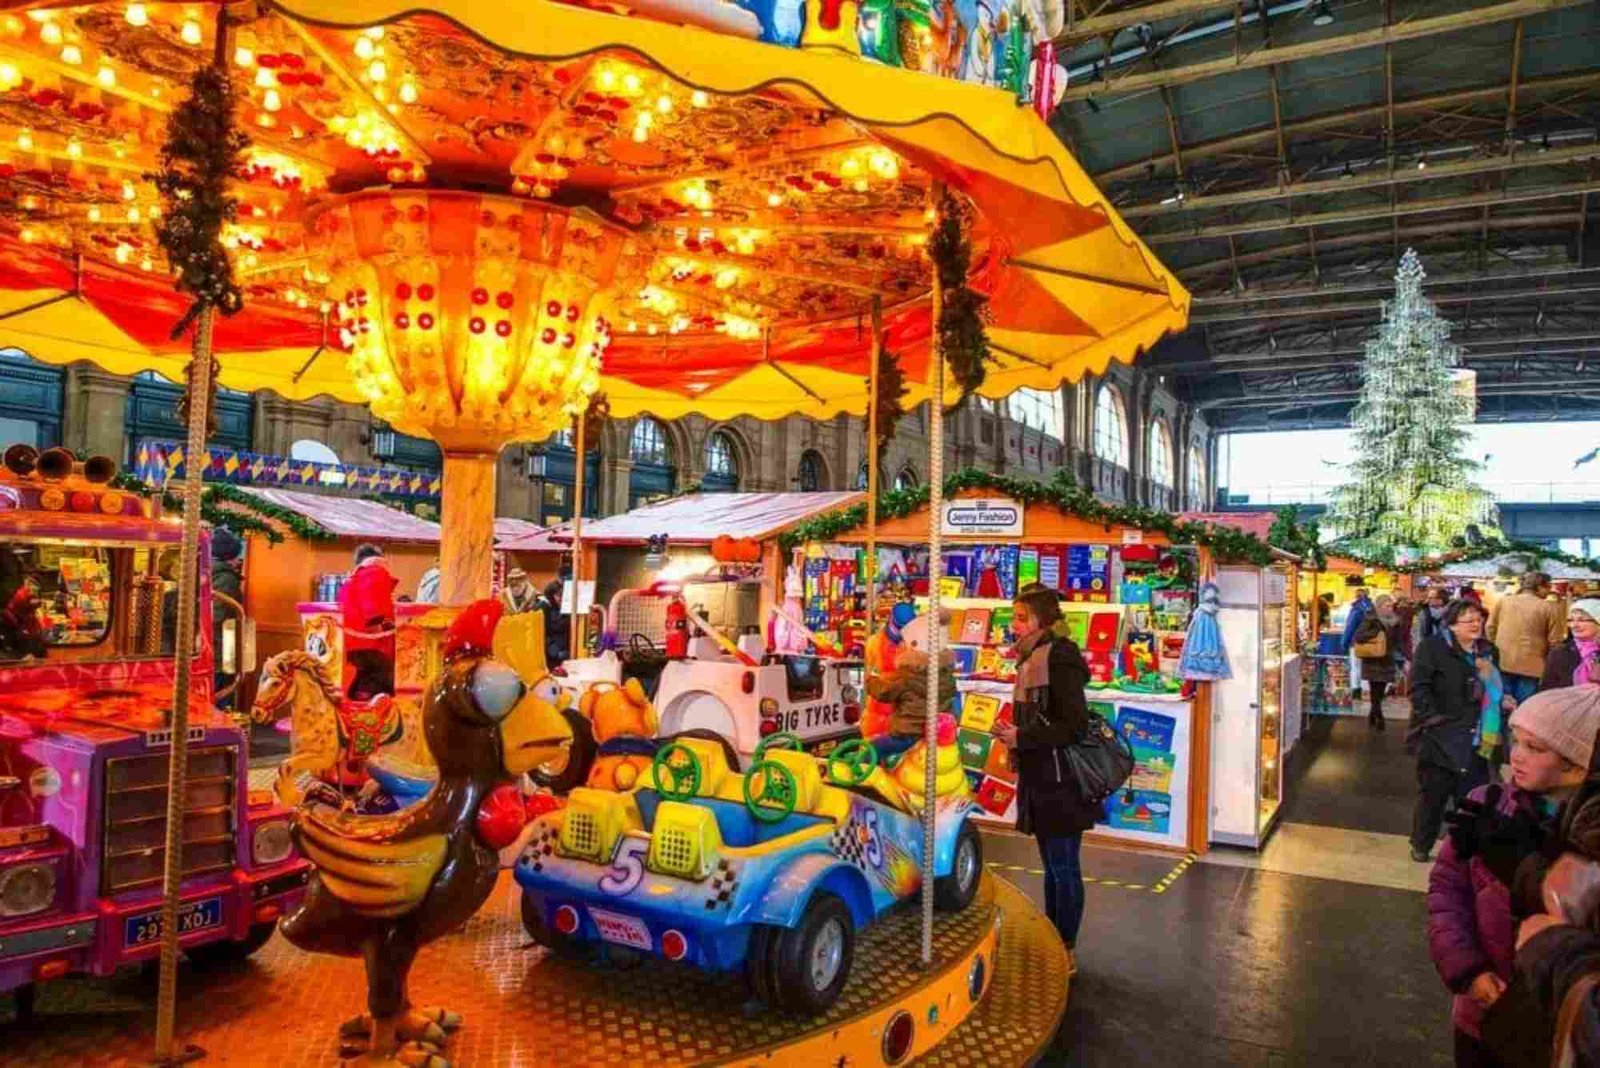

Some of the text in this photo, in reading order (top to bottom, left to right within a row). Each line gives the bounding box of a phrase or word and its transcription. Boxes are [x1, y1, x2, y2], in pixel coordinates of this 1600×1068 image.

[952, 512, 1014, 523] Jenny Fashion
[775, 703, 840, 732] BIG TYRE
[862, 806, 884, 868] 5
[599, 835, 648, 896] 5
